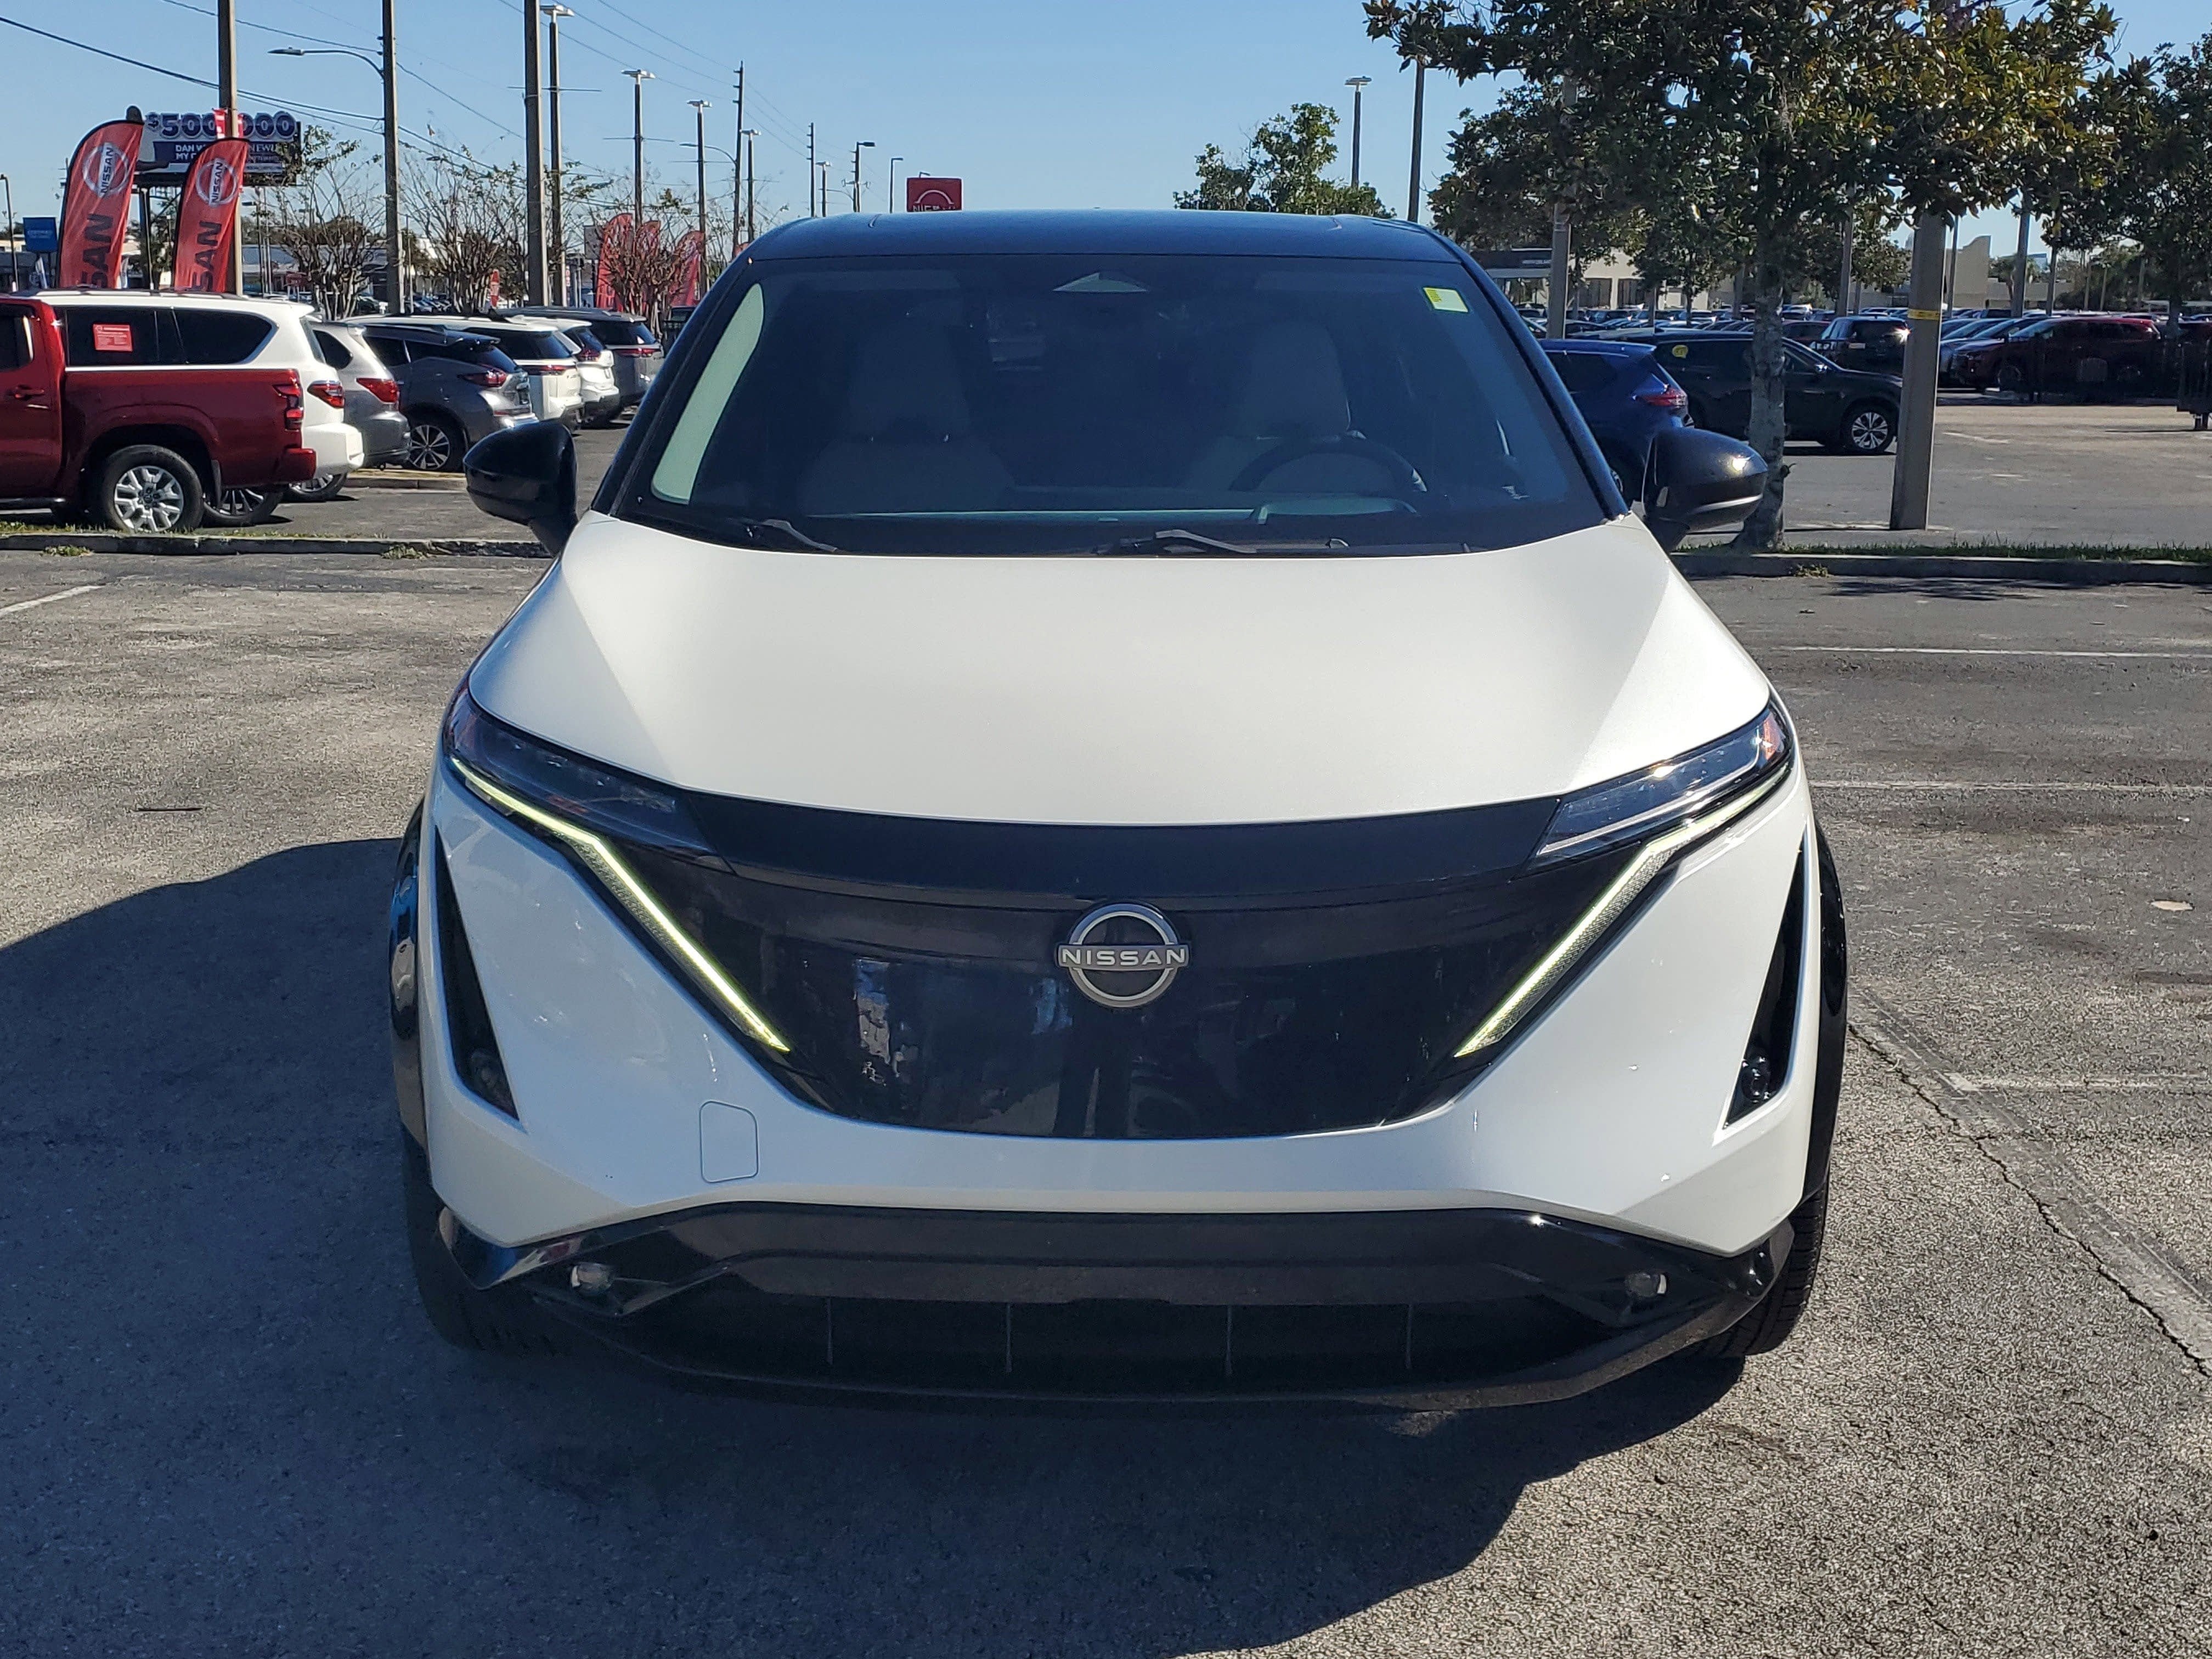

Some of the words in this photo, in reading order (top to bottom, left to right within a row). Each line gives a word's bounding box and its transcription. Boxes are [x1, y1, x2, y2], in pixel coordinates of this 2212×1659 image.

[100, 147, 114, 194] NISSAN
[211, 161, 223, 203] NISSAN
[1062, 949, 1185, 966] NISSAN
